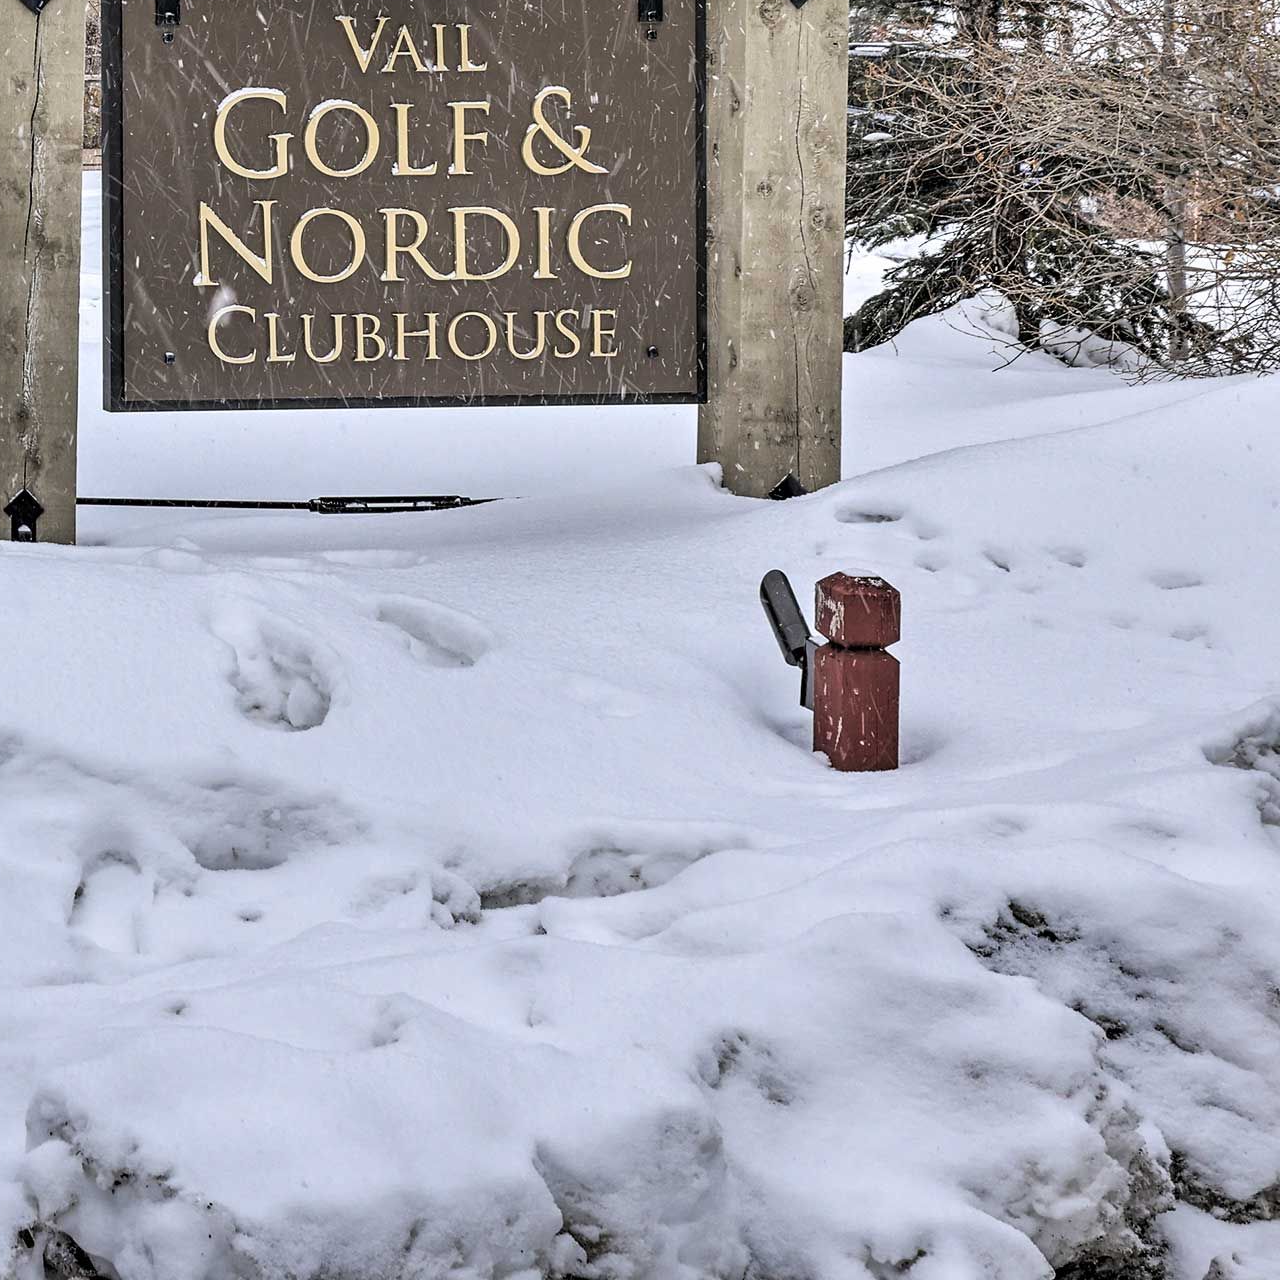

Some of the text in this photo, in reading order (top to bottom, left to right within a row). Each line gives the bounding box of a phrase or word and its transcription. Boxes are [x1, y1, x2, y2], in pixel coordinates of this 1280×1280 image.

[335, 15, 488, 74] VAIL
[213, 85, 609, 180] GOLF &
[192, 200, 633, 287] NORDIC
[207, 304, 619, 365] CLUBHOUSE
